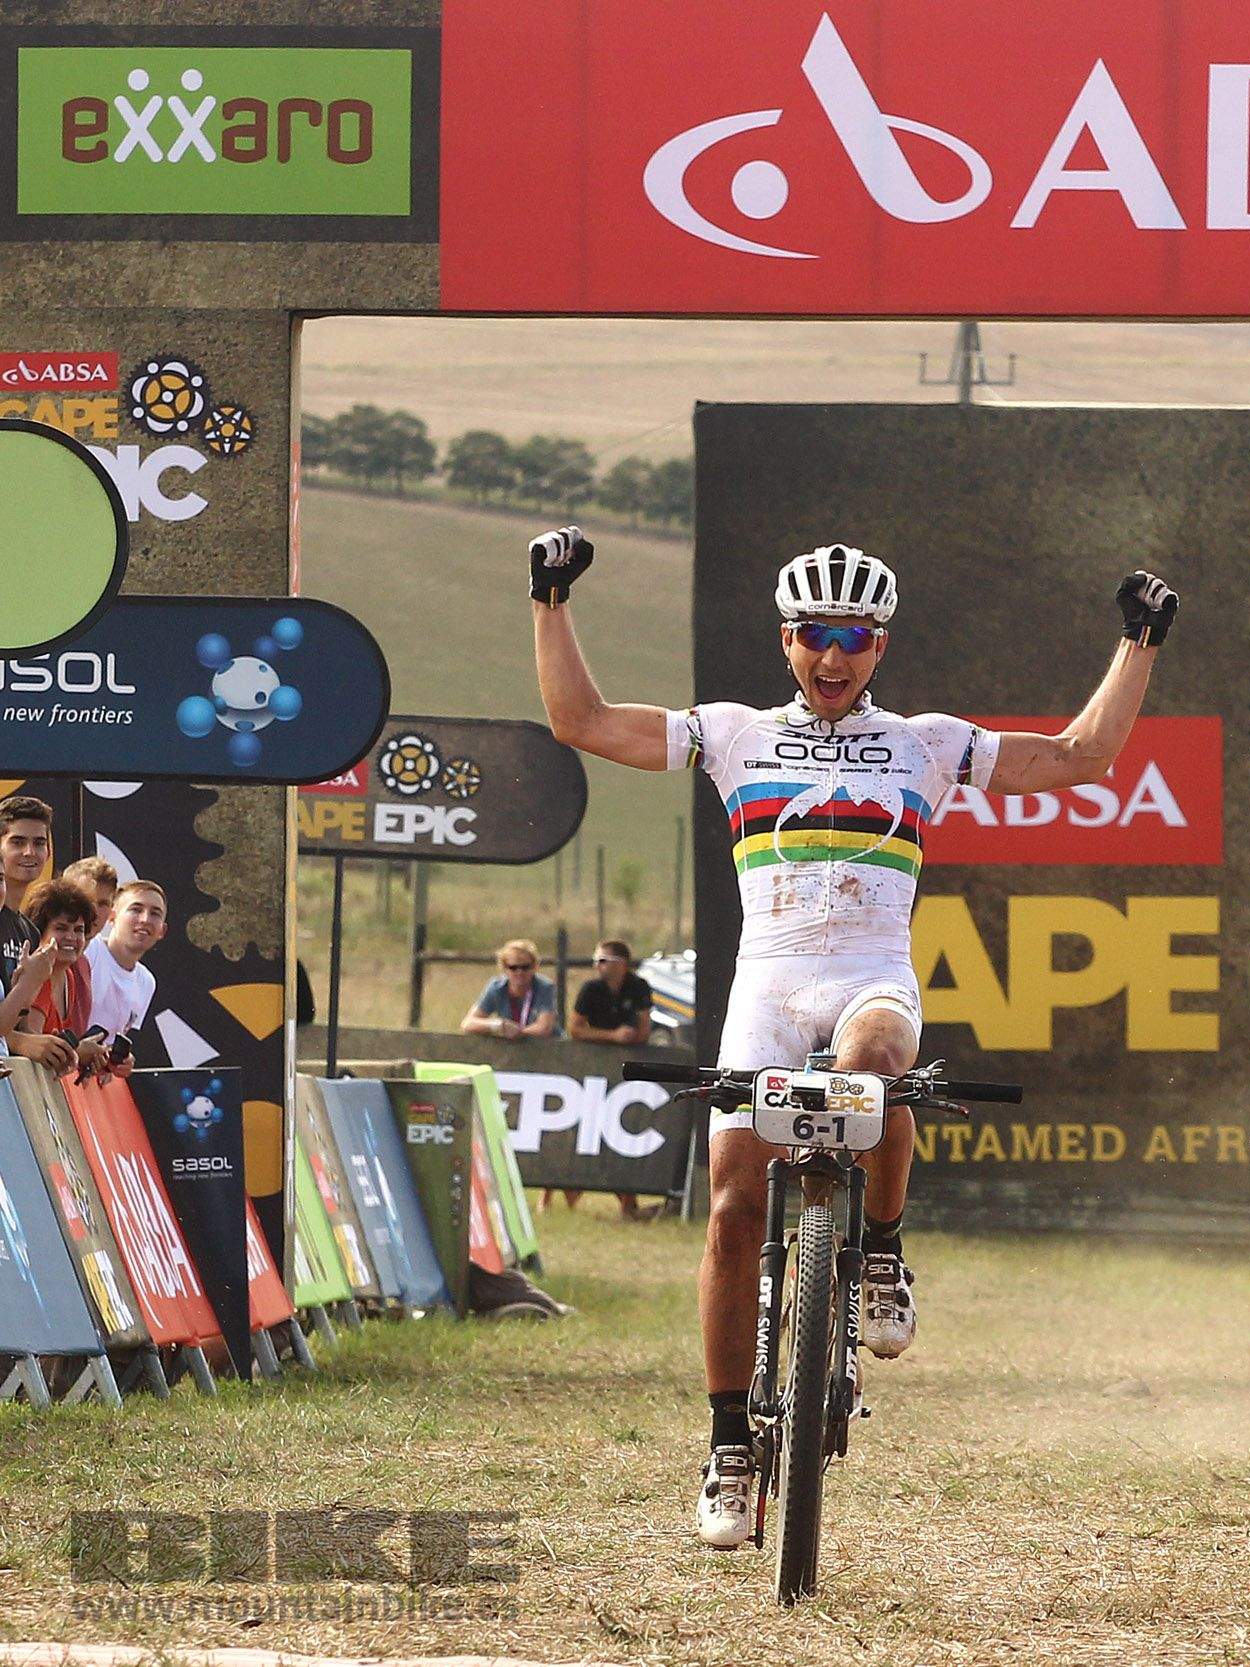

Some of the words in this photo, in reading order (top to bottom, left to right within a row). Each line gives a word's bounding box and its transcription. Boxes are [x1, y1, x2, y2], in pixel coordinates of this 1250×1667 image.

[62, 69, 373, 164] exxaro
[40, 363, 108, 382] ABSA
[85, 444, 209, 522] IC
[3, 706, 45, 721] new
[48, 703, 134, 728] frontiers
[297, 801, 368, 841] APE
[373, 802, 478, 846] EPIC
[909, 896, 1220, 1052] APE
[407, 1124, 454, 1145] EPIC
[793, 1114, 846, 1143] 6-1
[914, 1122, 1127, 1163] NTAMED
[758, 1276, 773, 1308] DT
[755, 1318, 771, 1375] SWISS
